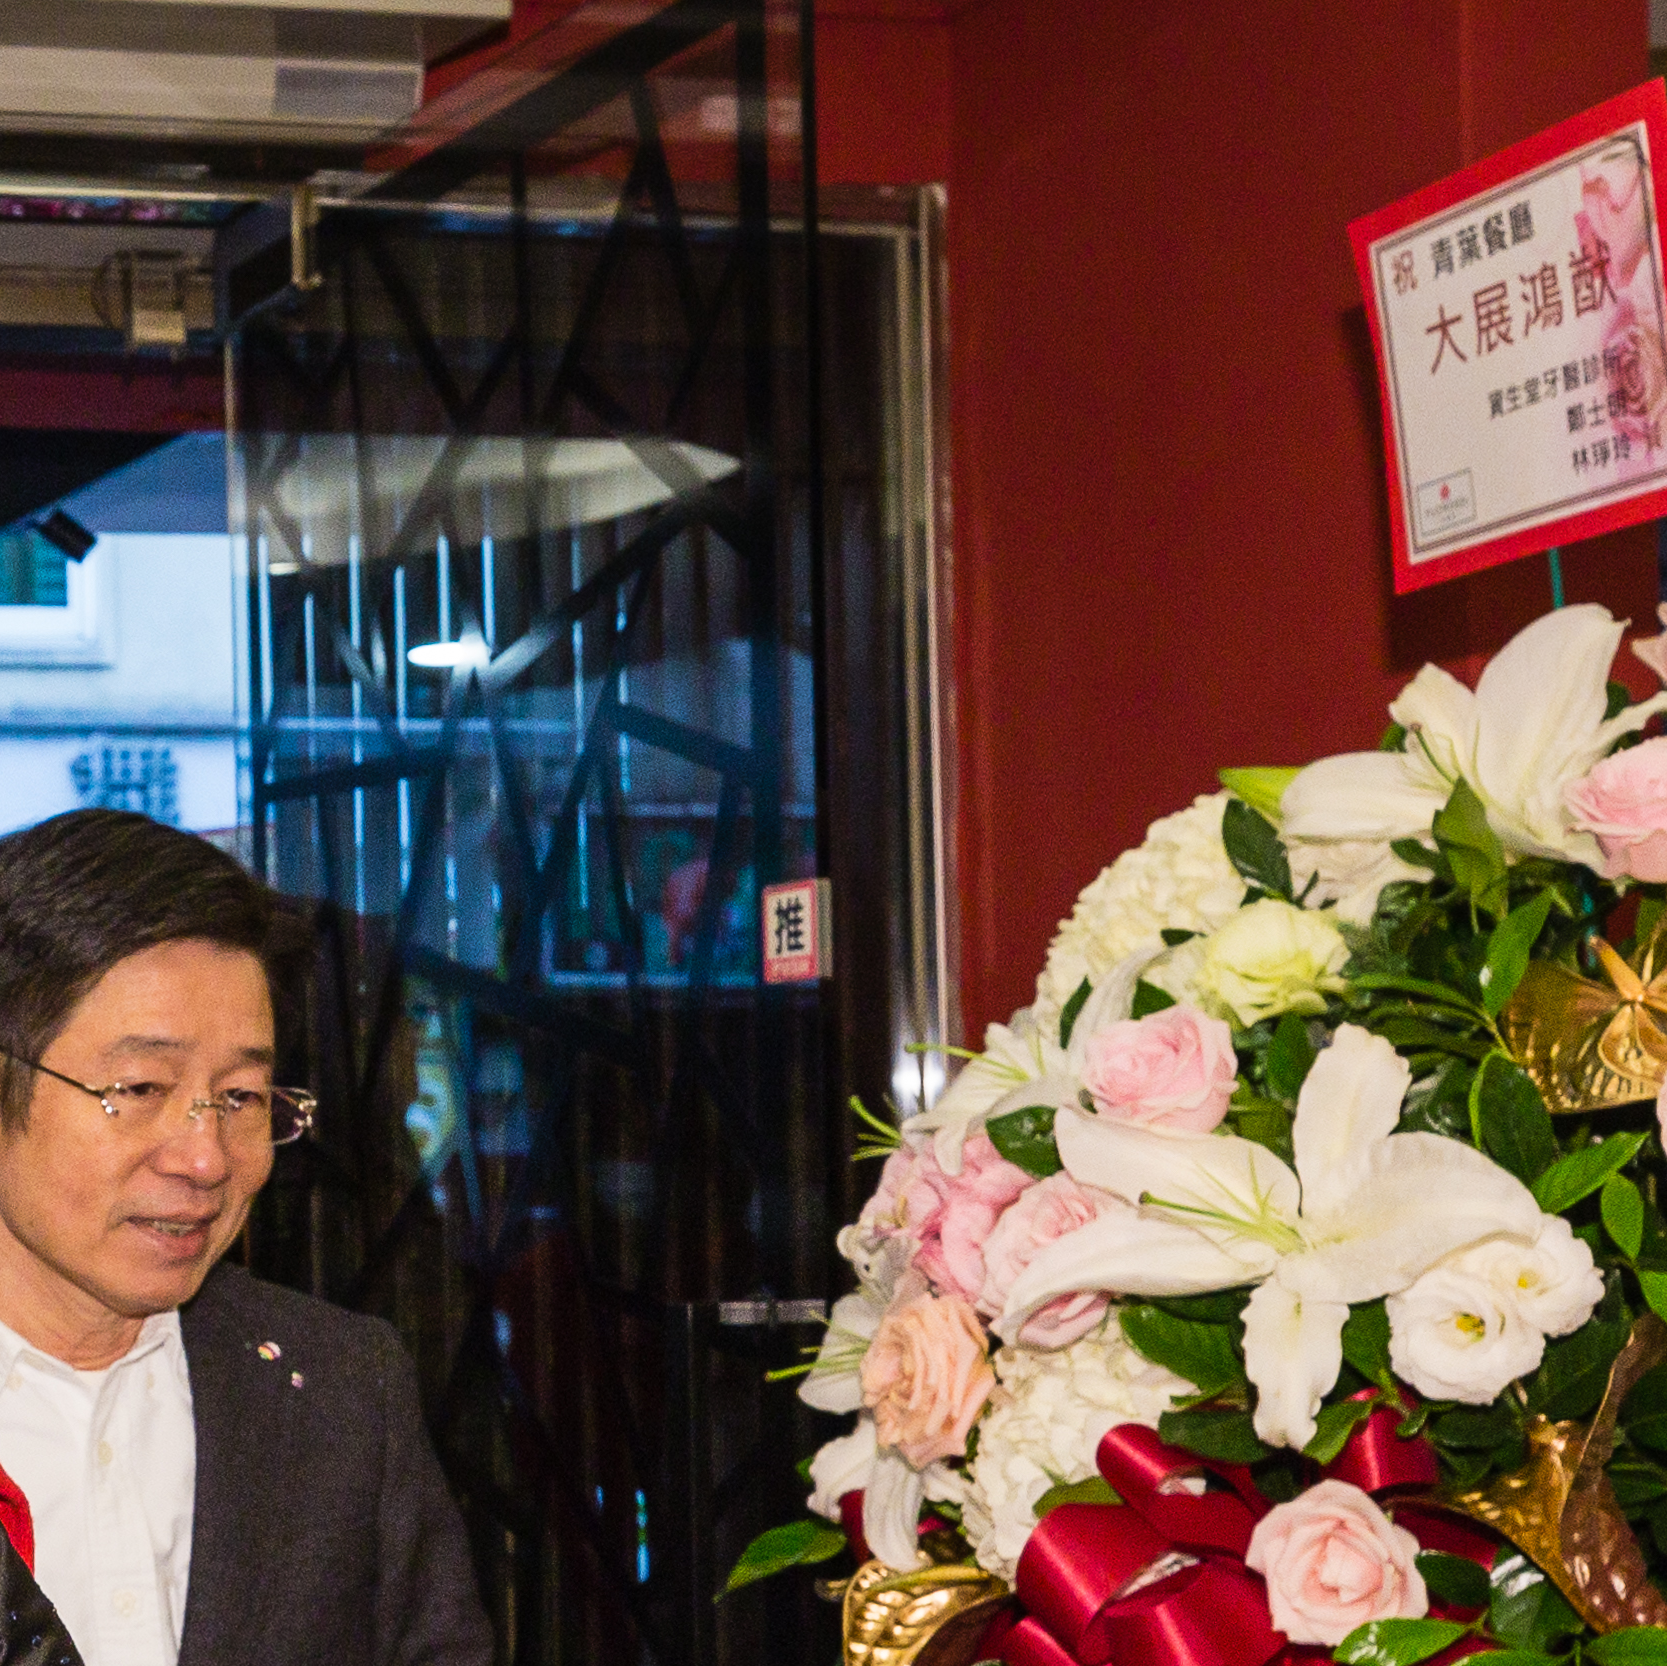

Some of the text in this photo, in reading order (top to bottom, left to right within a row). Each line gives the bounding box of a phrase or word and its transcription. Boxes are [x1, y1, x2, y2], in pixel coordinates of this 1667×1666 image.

[1391, 249, 1418, 296] 祝
[1425, 234, 1617, 375] 大展鴻猷
[775, 895, 805, 955] 推
